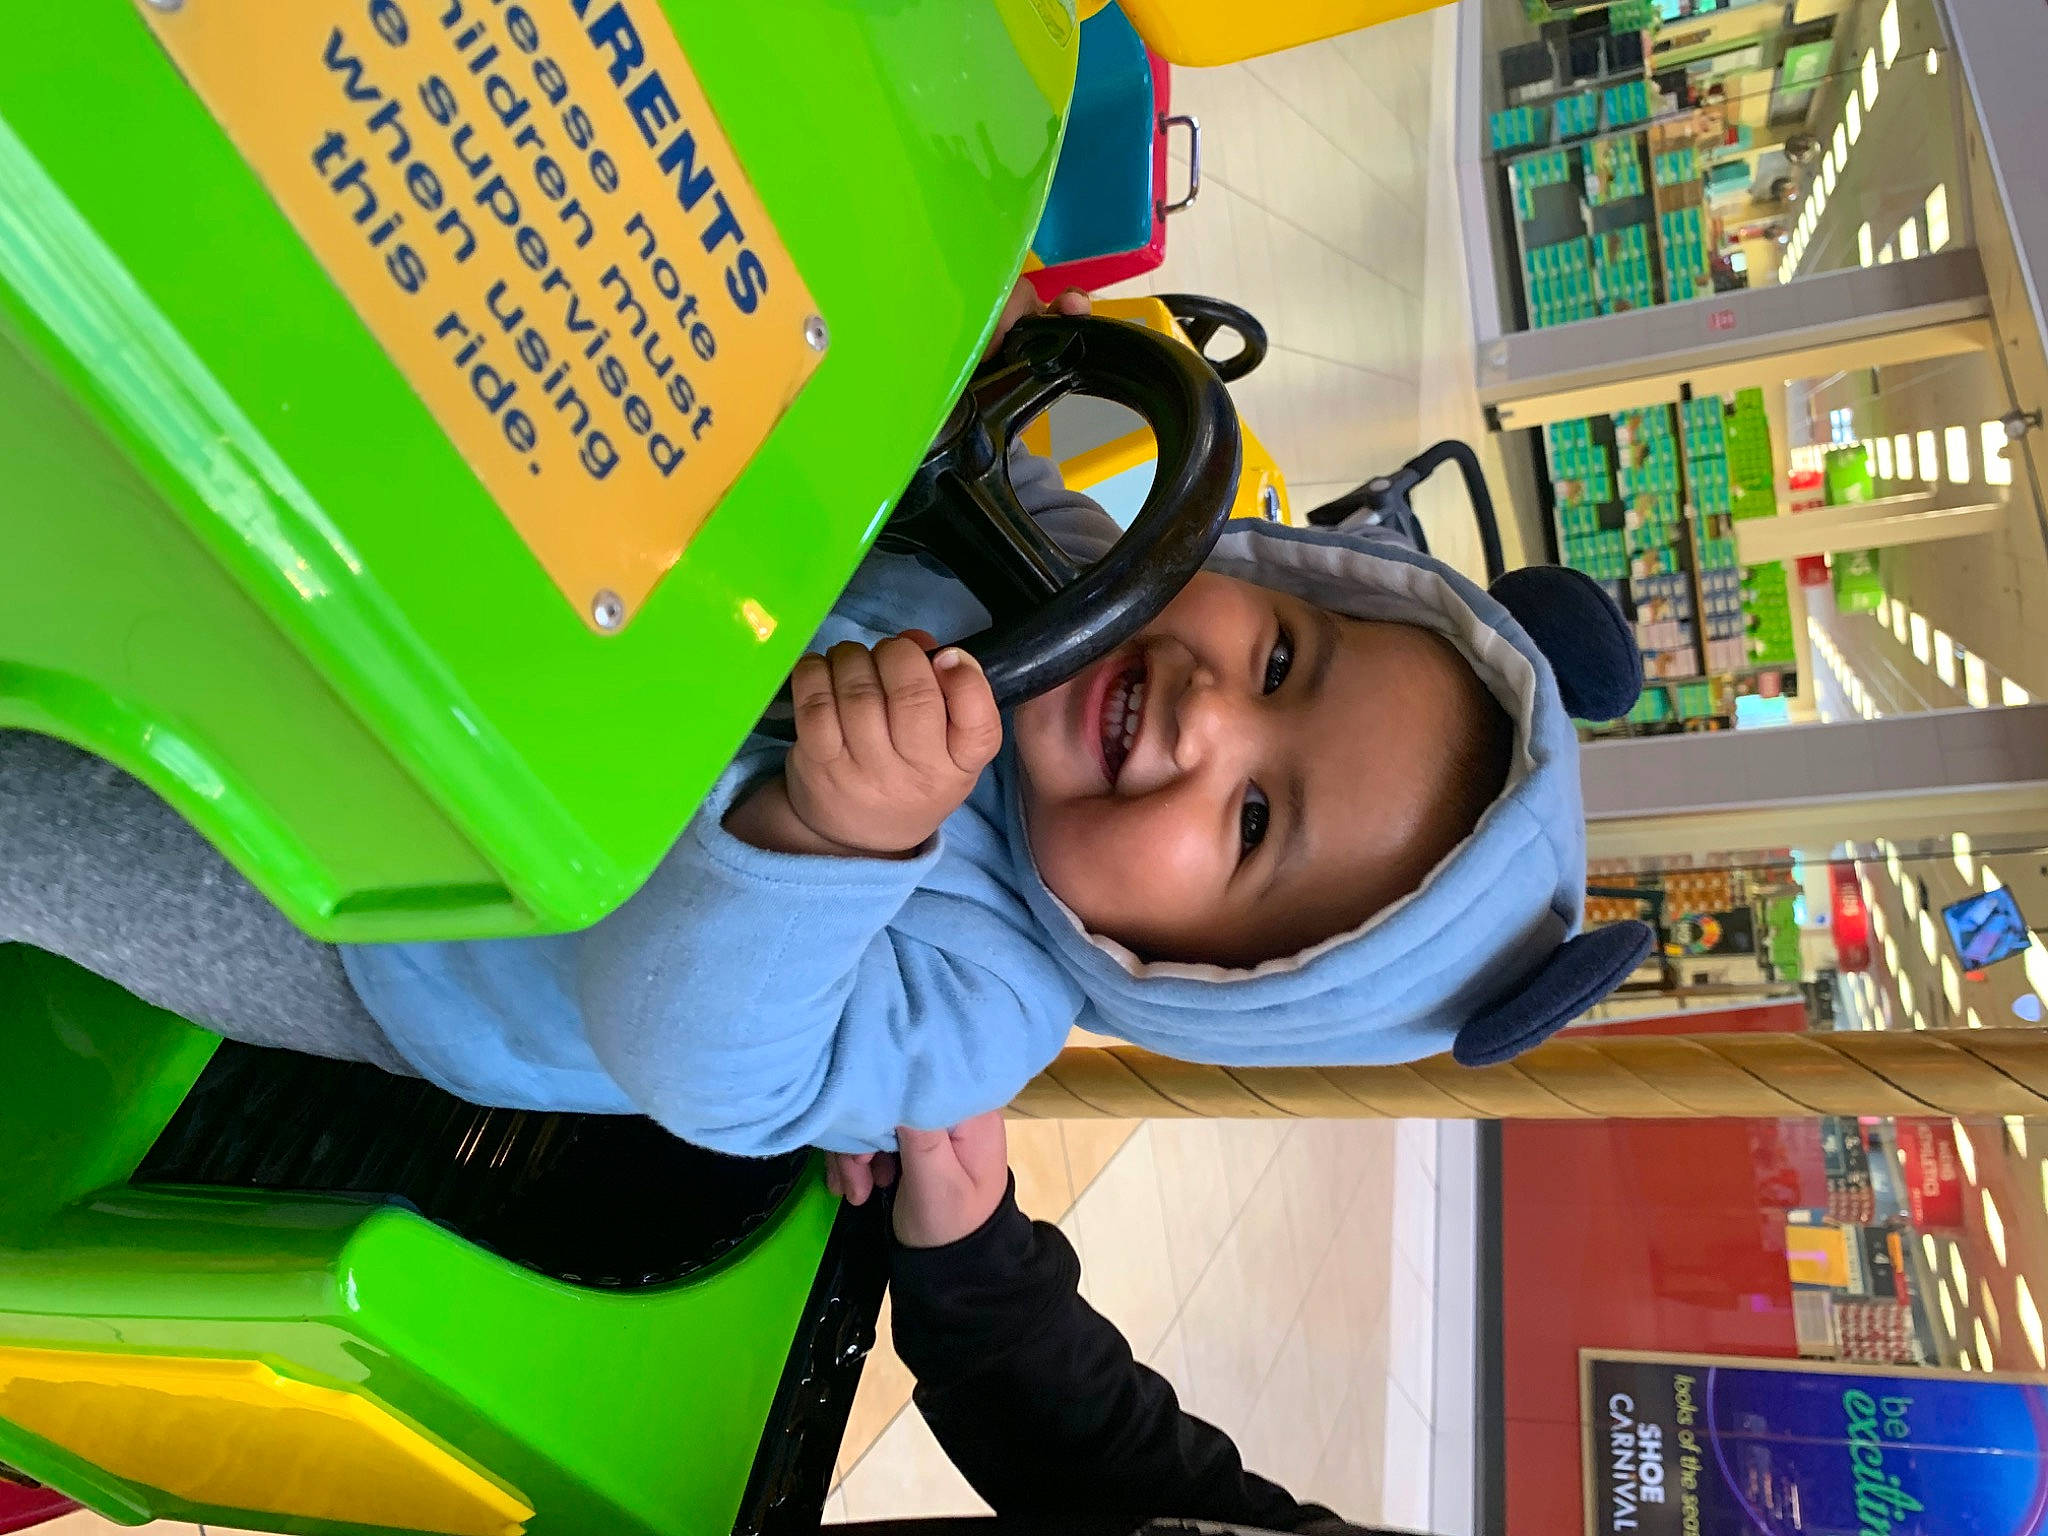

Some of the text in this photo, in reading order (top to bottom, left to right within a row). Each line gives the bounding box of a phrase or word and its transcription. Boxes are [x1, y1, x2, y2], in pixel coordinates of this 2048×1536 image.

[491, 0, 717, 361] ease note
[571, 0, 769, 315] RENTS
[311, 131, 541, 476] this ride.
[323, 27, 621, 480] when using
[419, 75, 686, 478] supervised
[601, 265, 714, 441] must
[1608, 1392, 1639, 1532] CARNIVAL
[1637, 1422, 1666, 1504] SHOE
[1673, 1374, 1699, 1426] looks
[1677, 1429, 1702, 1455] of
[1680, 1455, 1703, 1490] the
[1879, 1396, 1914, 1438] be
